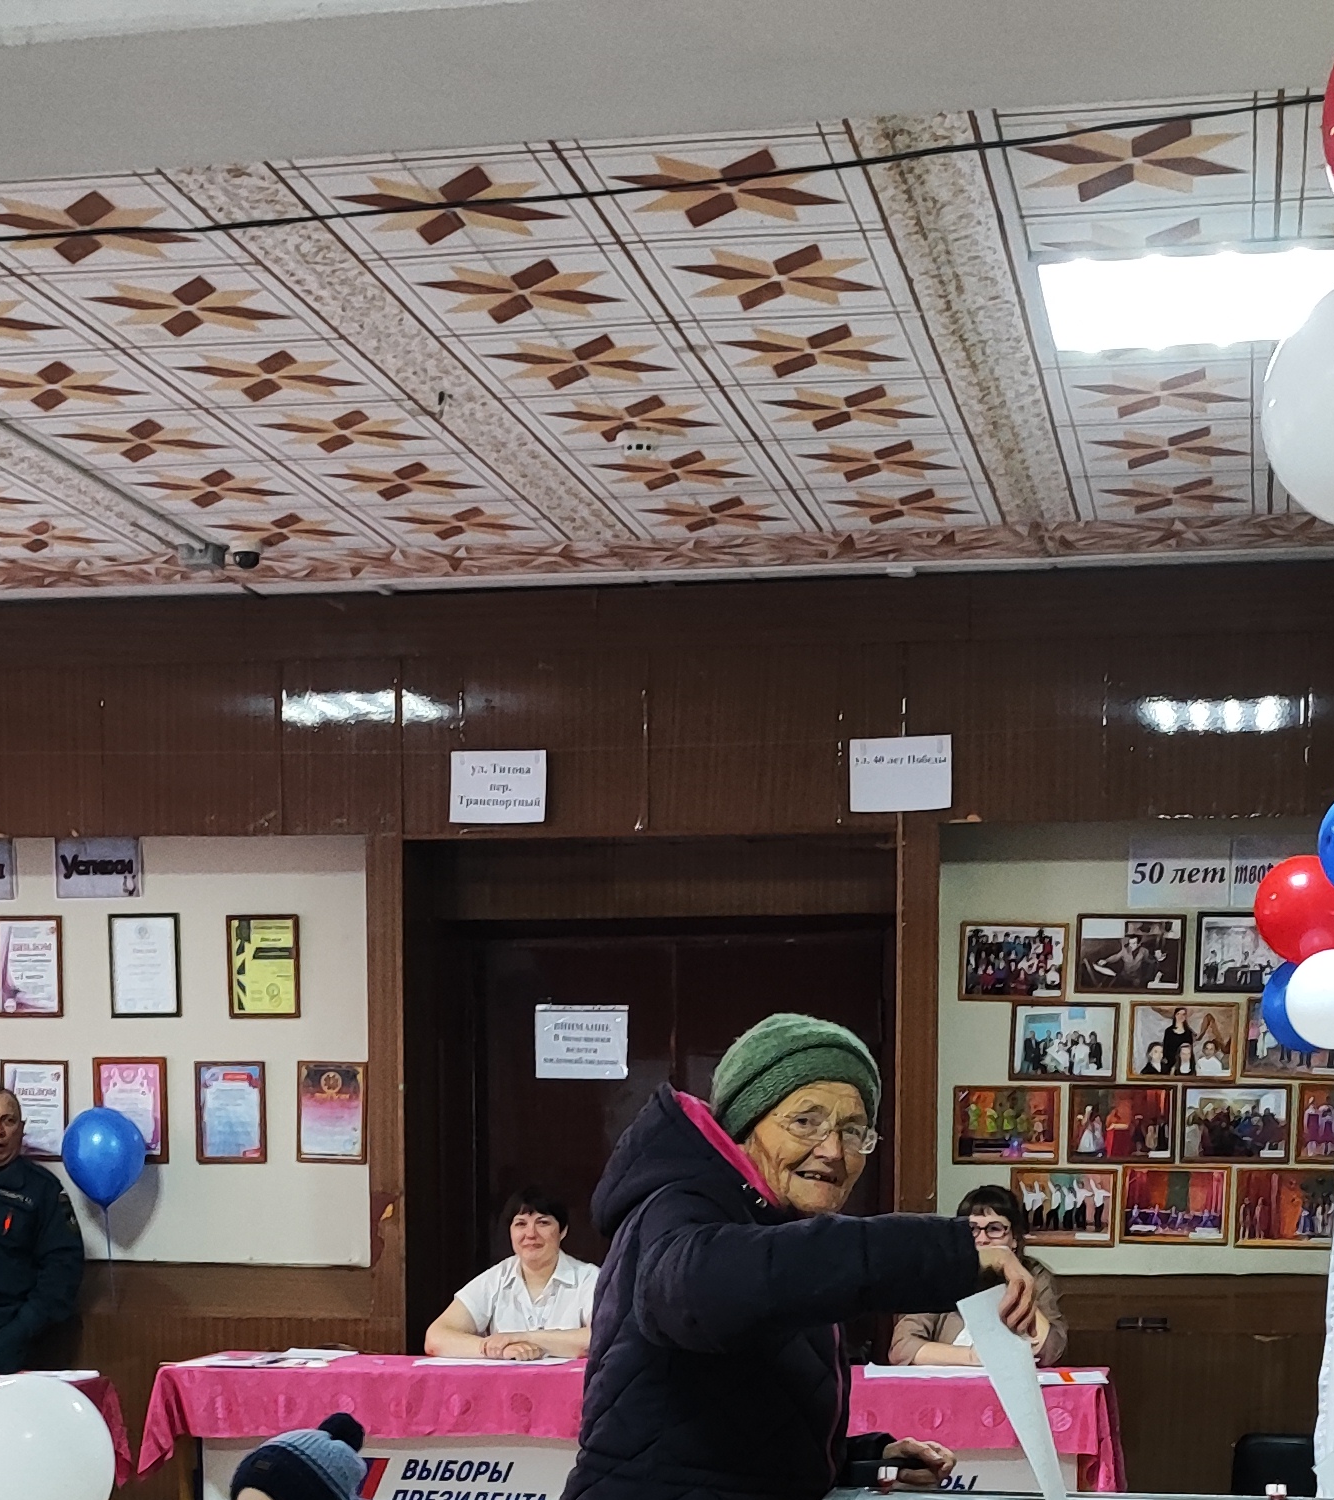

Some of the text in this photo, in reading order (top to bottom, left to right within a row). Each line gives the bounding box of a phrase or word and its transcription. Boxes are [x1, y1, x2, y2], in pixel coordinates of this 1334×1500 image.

[470, 765, 487, 776] ул.
[457, 795, 541, 810] Транспортный
[1131, 861, 1165, 885] 50
[1169, 866, 1226, 884] лет
[401, 1458, 514, 1484] ВЫБОРЫ
